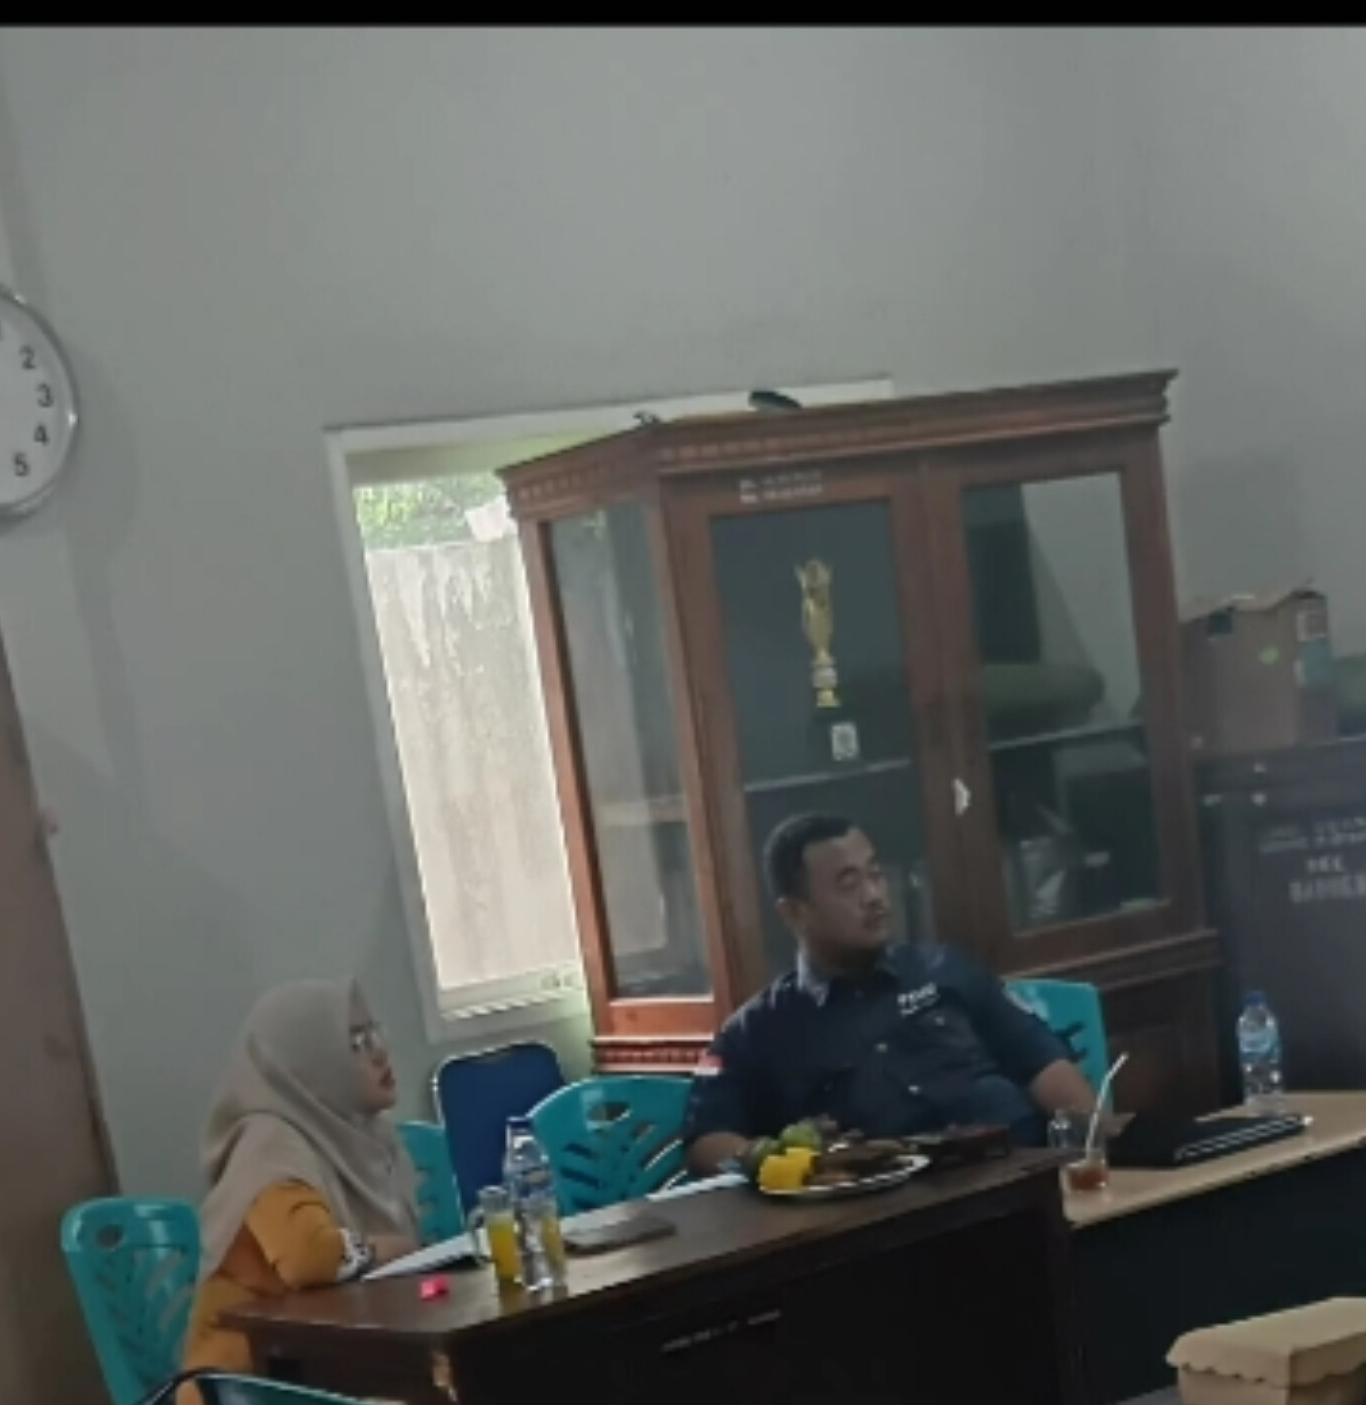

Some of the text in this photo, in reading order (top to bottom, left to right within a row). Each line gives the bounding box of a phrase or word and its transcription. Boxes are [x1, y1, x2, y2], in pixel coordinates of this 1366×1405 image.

[19, 346, 36, 370] 2
[37, 383, 54, 408] 3
[34, 425, 49, 446] 4
[14, 453, 30, 477] 5
